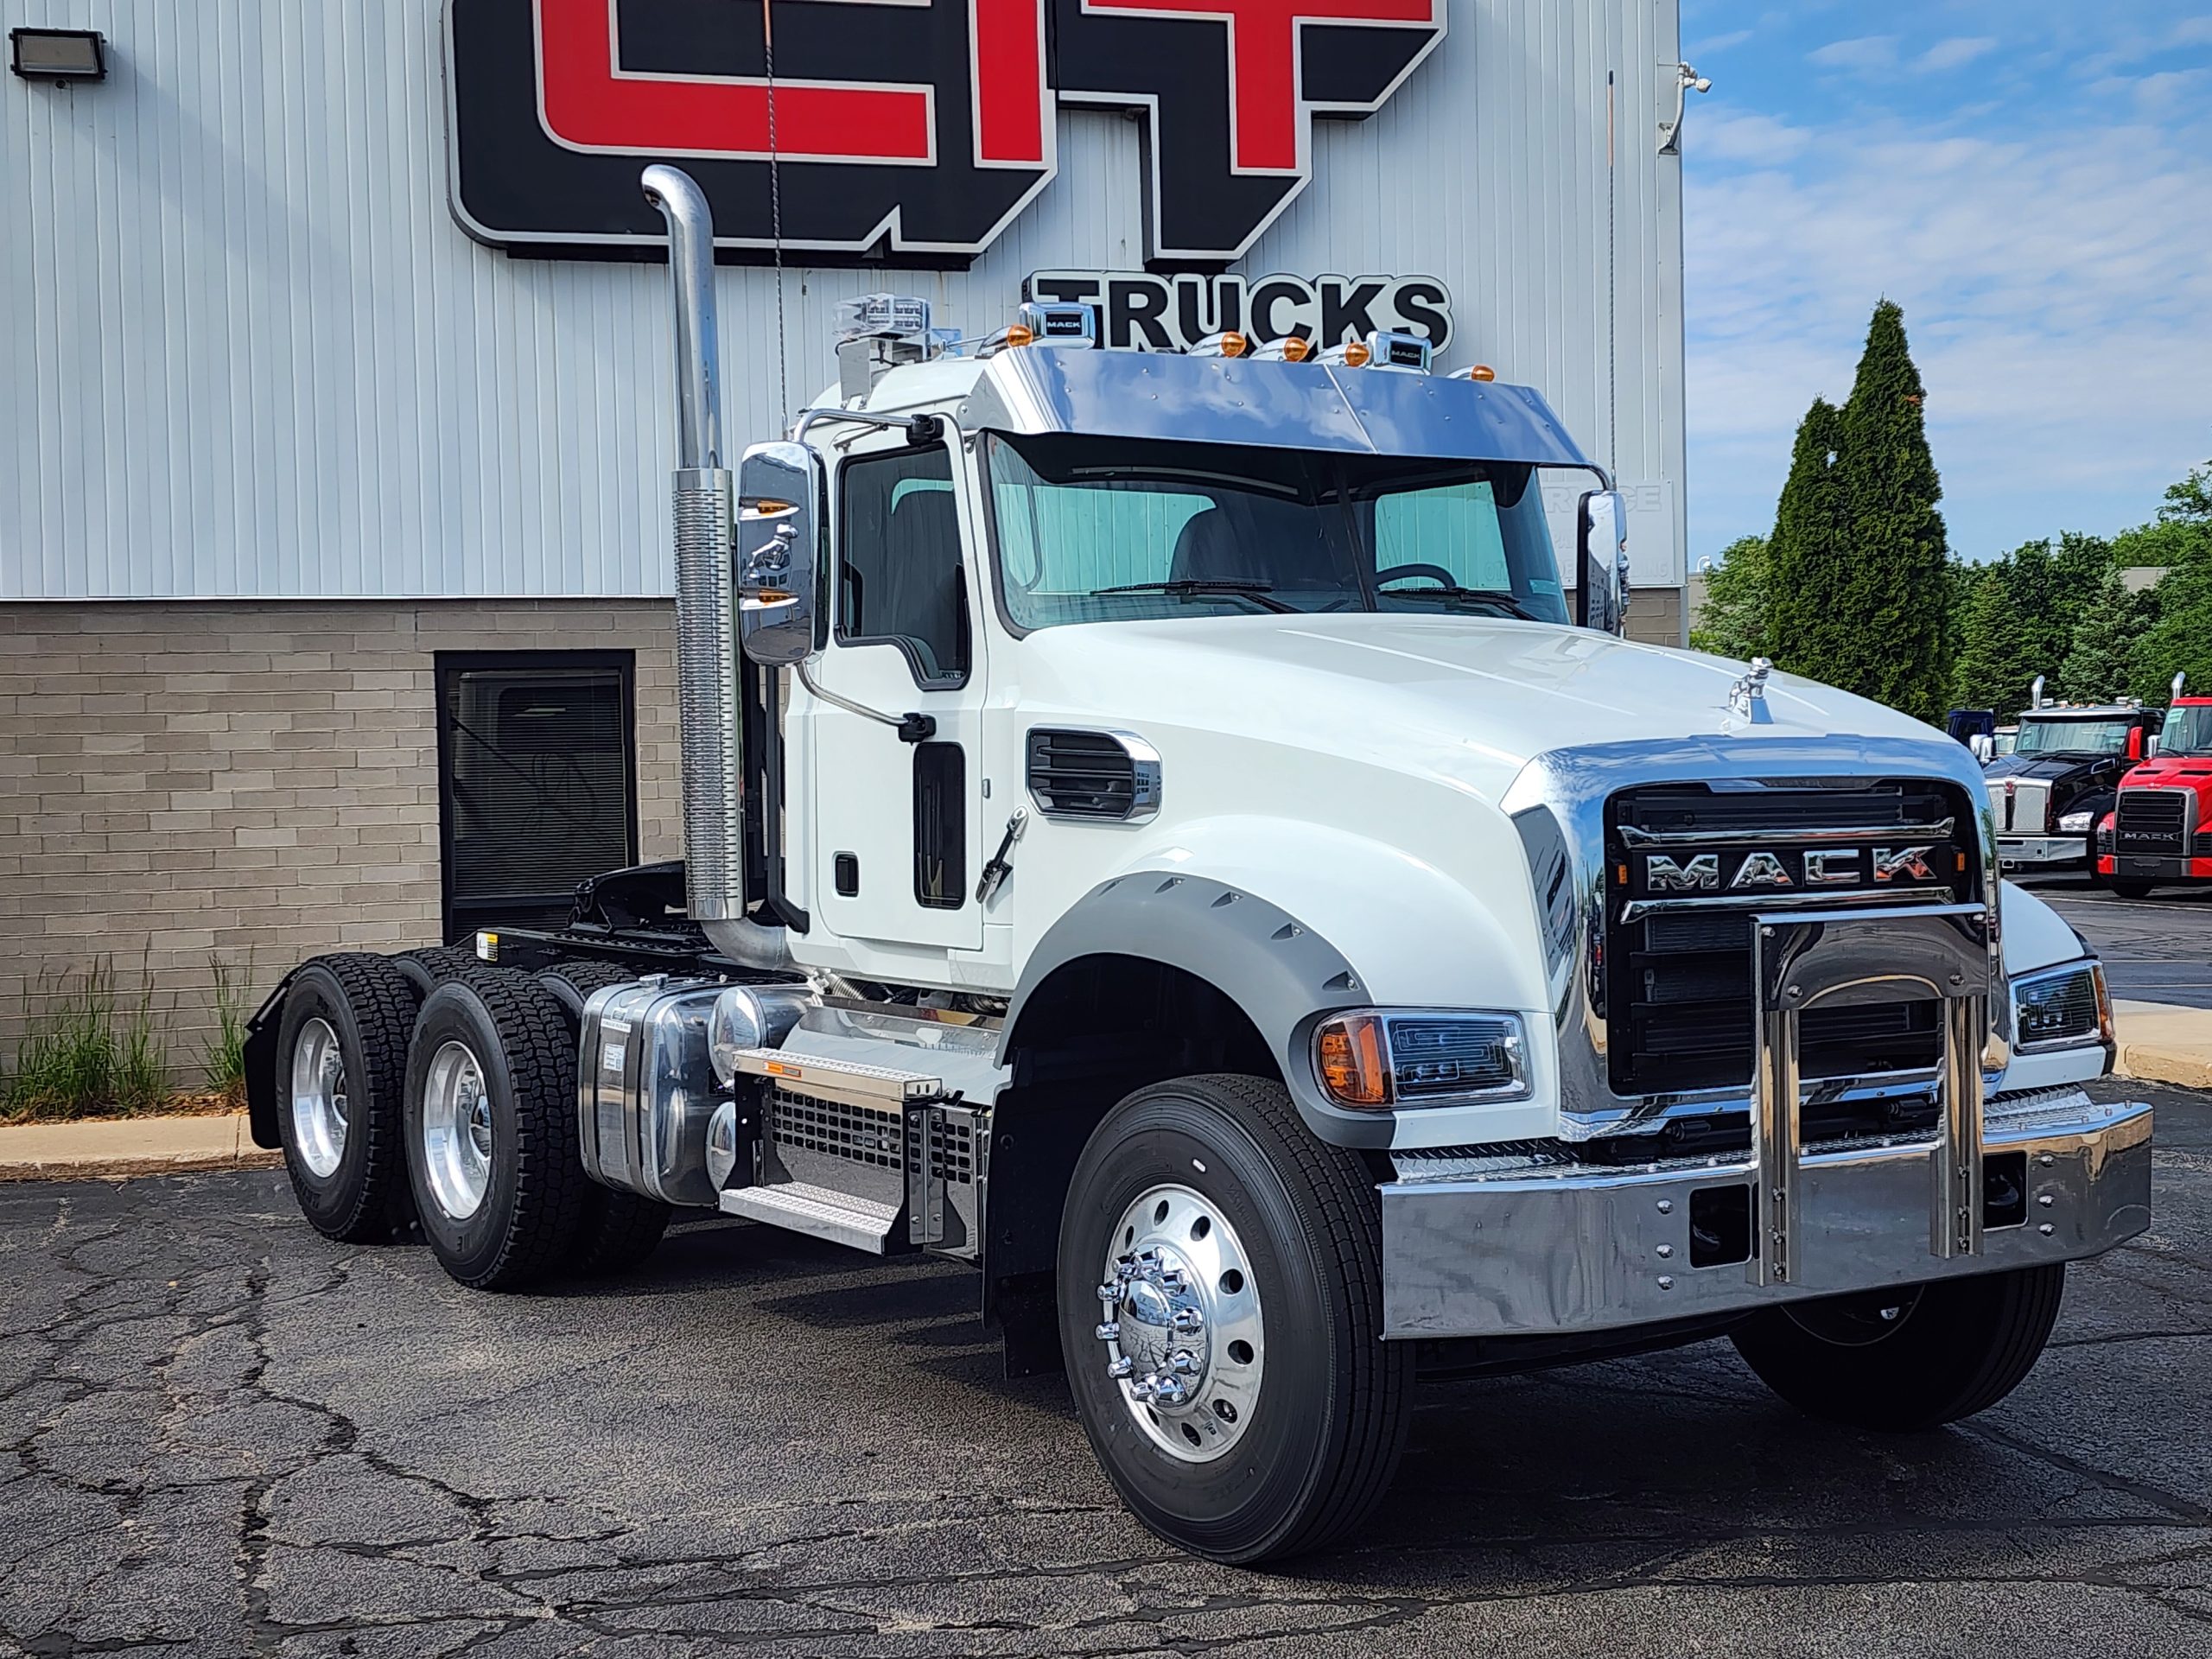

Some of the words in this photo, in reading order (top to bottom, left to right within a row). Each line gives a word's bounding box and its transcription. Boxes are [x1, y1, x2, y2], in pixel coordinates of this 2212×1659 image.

[1033, 275, 1451, 353] TRUCKS
[1391, 349, 1421, 359] MACK
[2124, 832, 2174, 841] MACK
[1646, 846, 1938, 892] MACK
